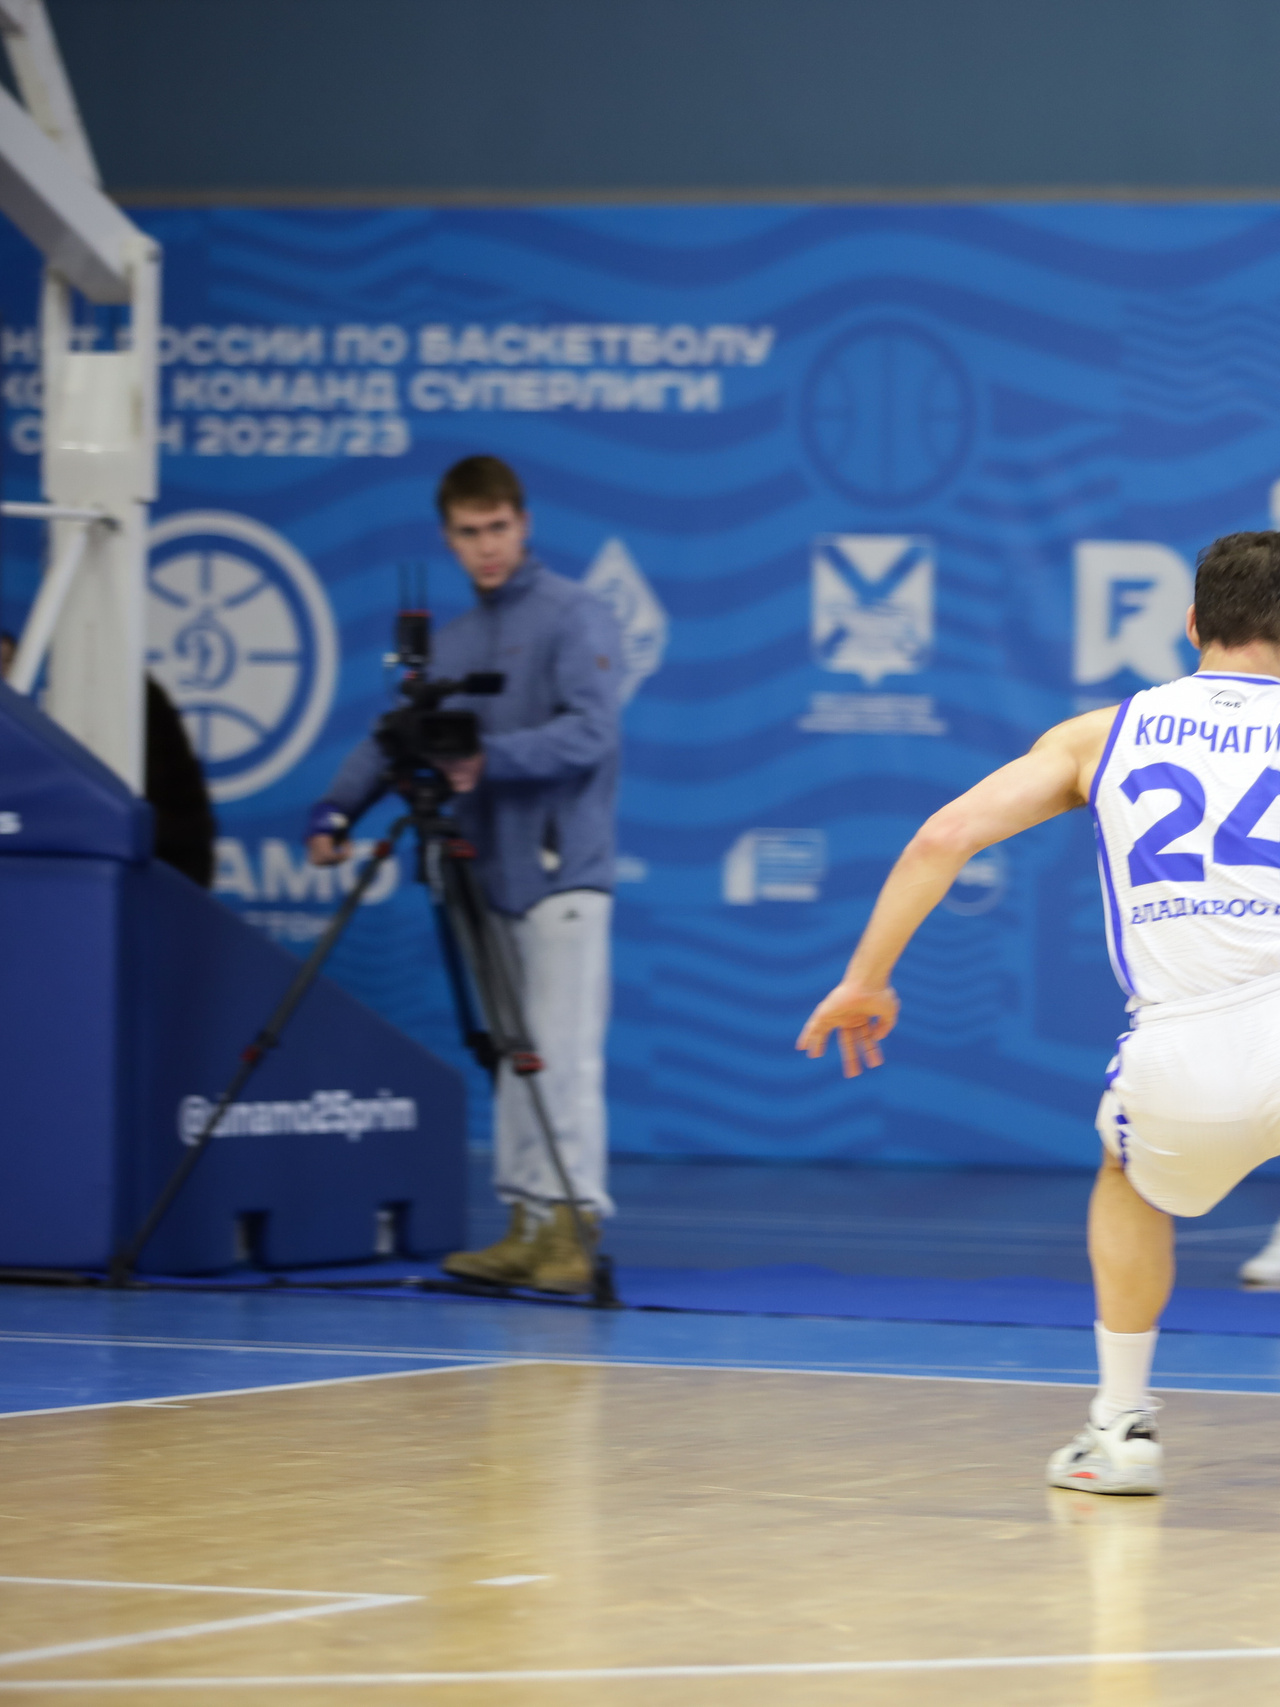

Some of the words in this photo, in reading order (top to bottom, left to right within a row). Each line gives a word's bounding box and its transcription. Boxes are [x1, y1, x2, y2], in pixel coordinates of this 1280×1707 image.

[333, 324, 408, 365] ПО
[419, 324, 774, 366] БАСКЕТБОЛУ
[173, 371, 401, 413] КОМАНД
[409, 371, 722, 411] СУПЕРЛИГИ
[196, 415, 410, 456] 2022/23
